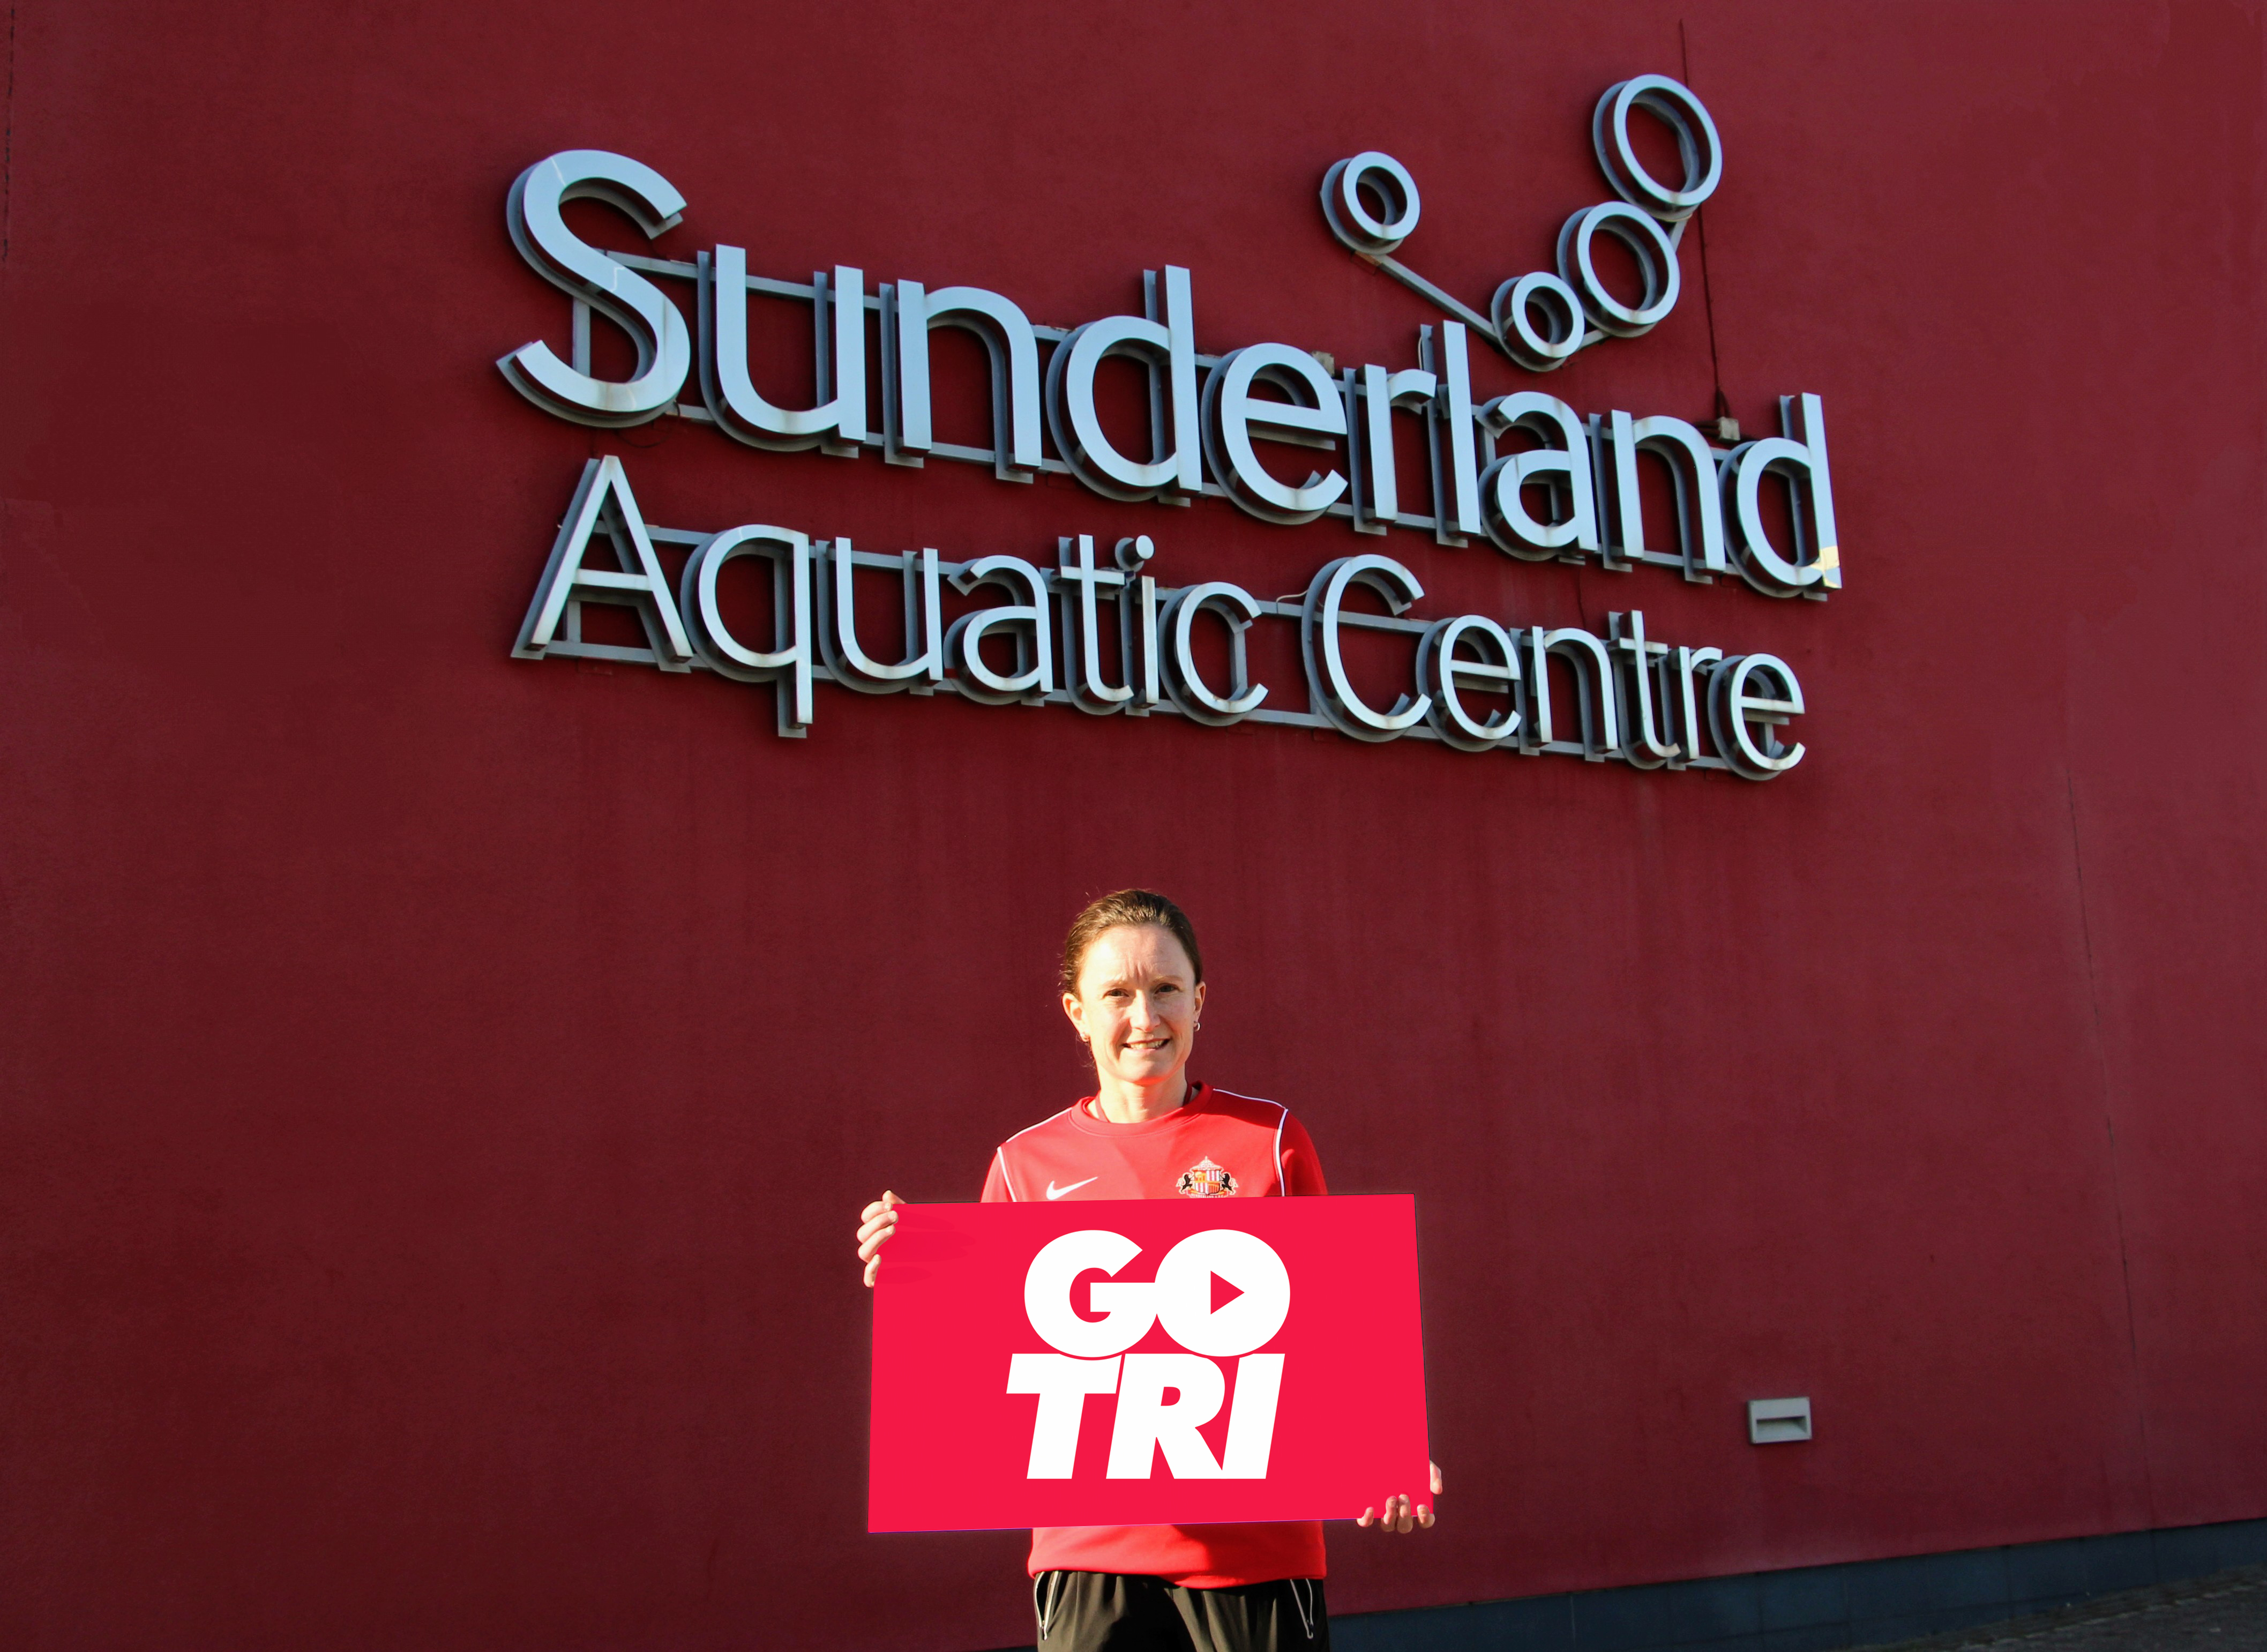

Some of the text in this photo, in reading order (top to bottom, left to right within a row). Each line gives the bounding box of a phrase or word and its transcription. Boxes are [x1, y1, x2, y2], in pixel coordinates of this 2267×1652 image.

[511, 149, 1843, 590] Sunderland
[530, 455, 1806, 771] Aquatic Centre
[1024, 1229, 1290, 1357] GO
[1006, 1354, 1285, 1479] TRI
